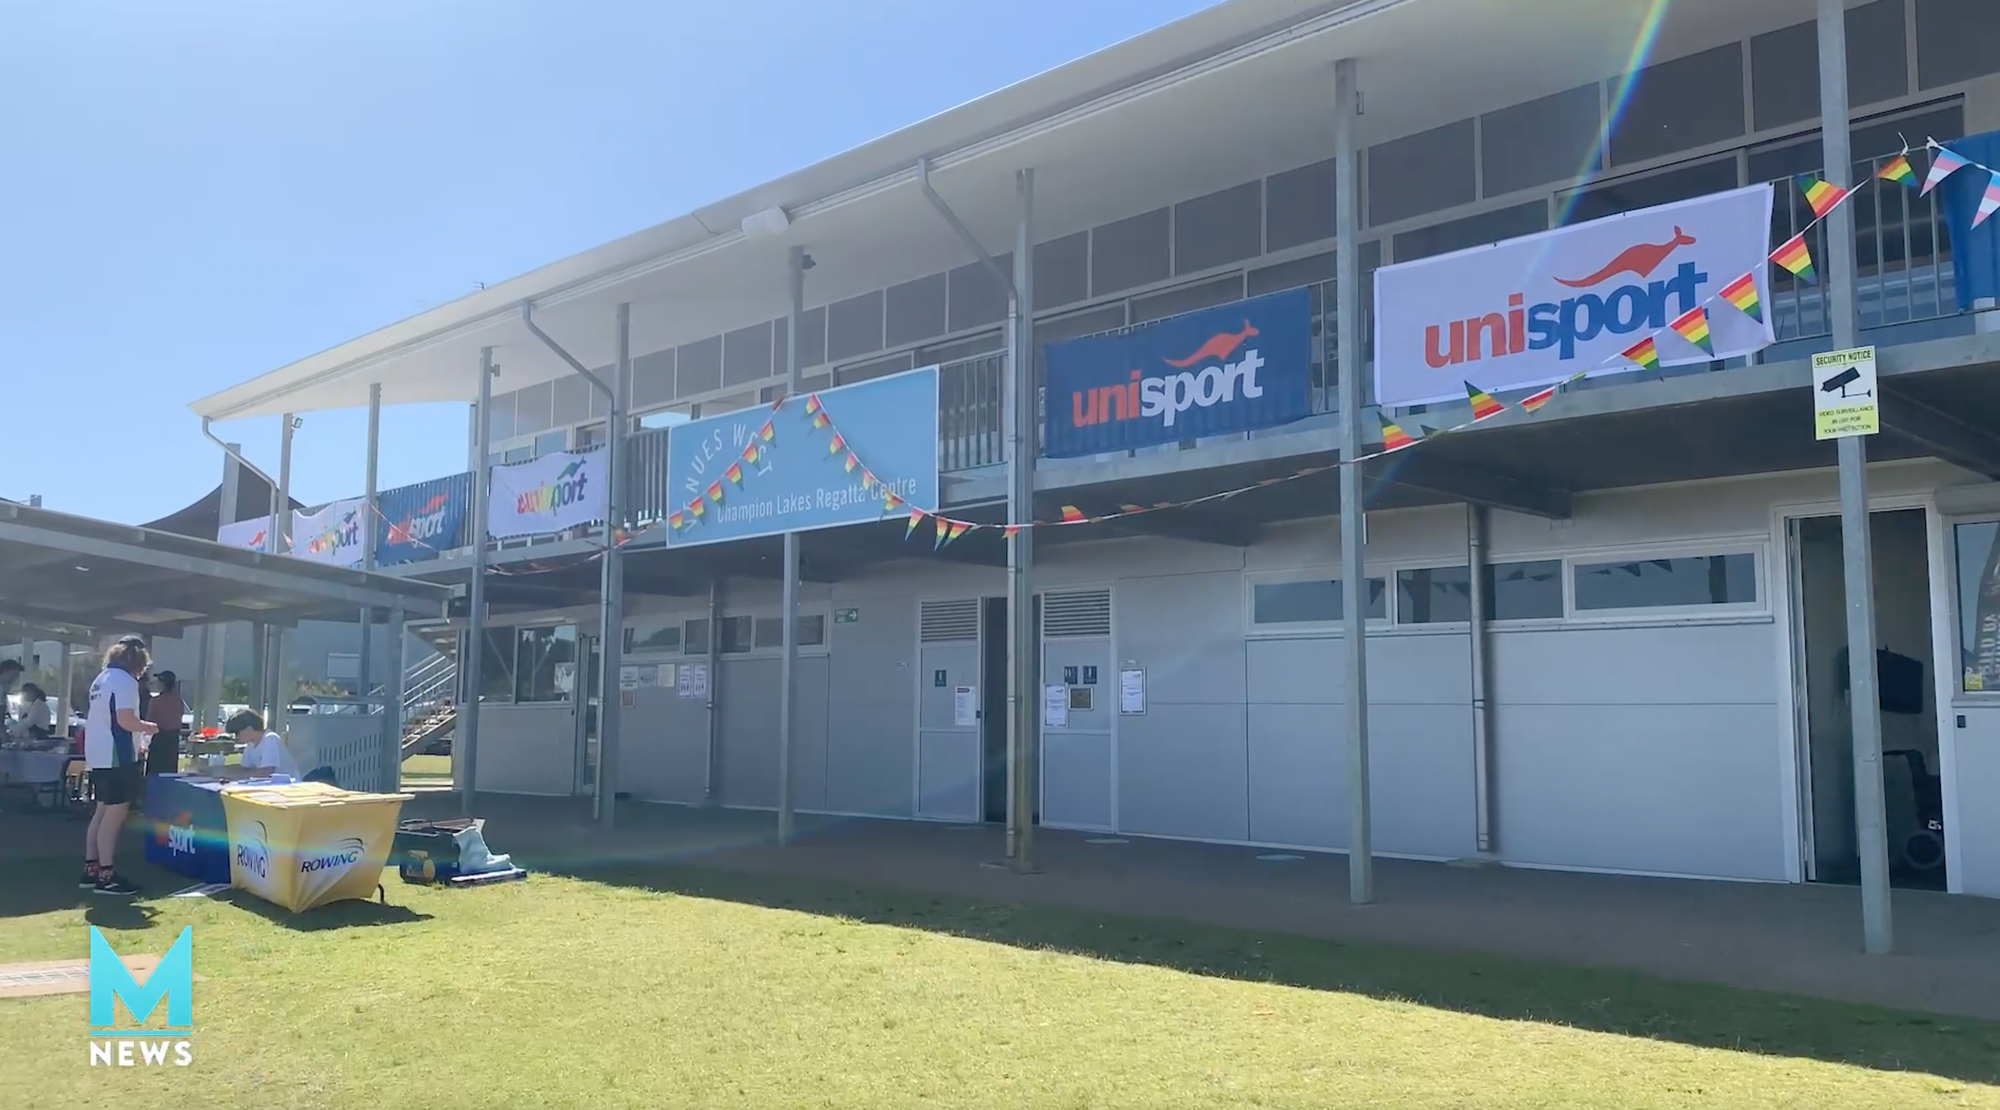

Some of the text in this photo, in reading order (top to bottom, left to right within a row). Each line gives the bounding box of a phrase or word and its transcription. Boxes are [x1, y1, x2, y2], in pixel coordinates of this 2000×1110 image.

[1425, 261, 1708, 368] unisport
[1815, 350, 1871, 366] SECURITY NOTICE
[1072, 349, 1264, 427] unisport
[717, 498, 773, 523] Champion
[777, 493, 811, 515] Lakes
[816, 484, 866, 511] Regatta
[237, 844, 266, 878] ROWING
[301, 851, 358, 873] ROWING
